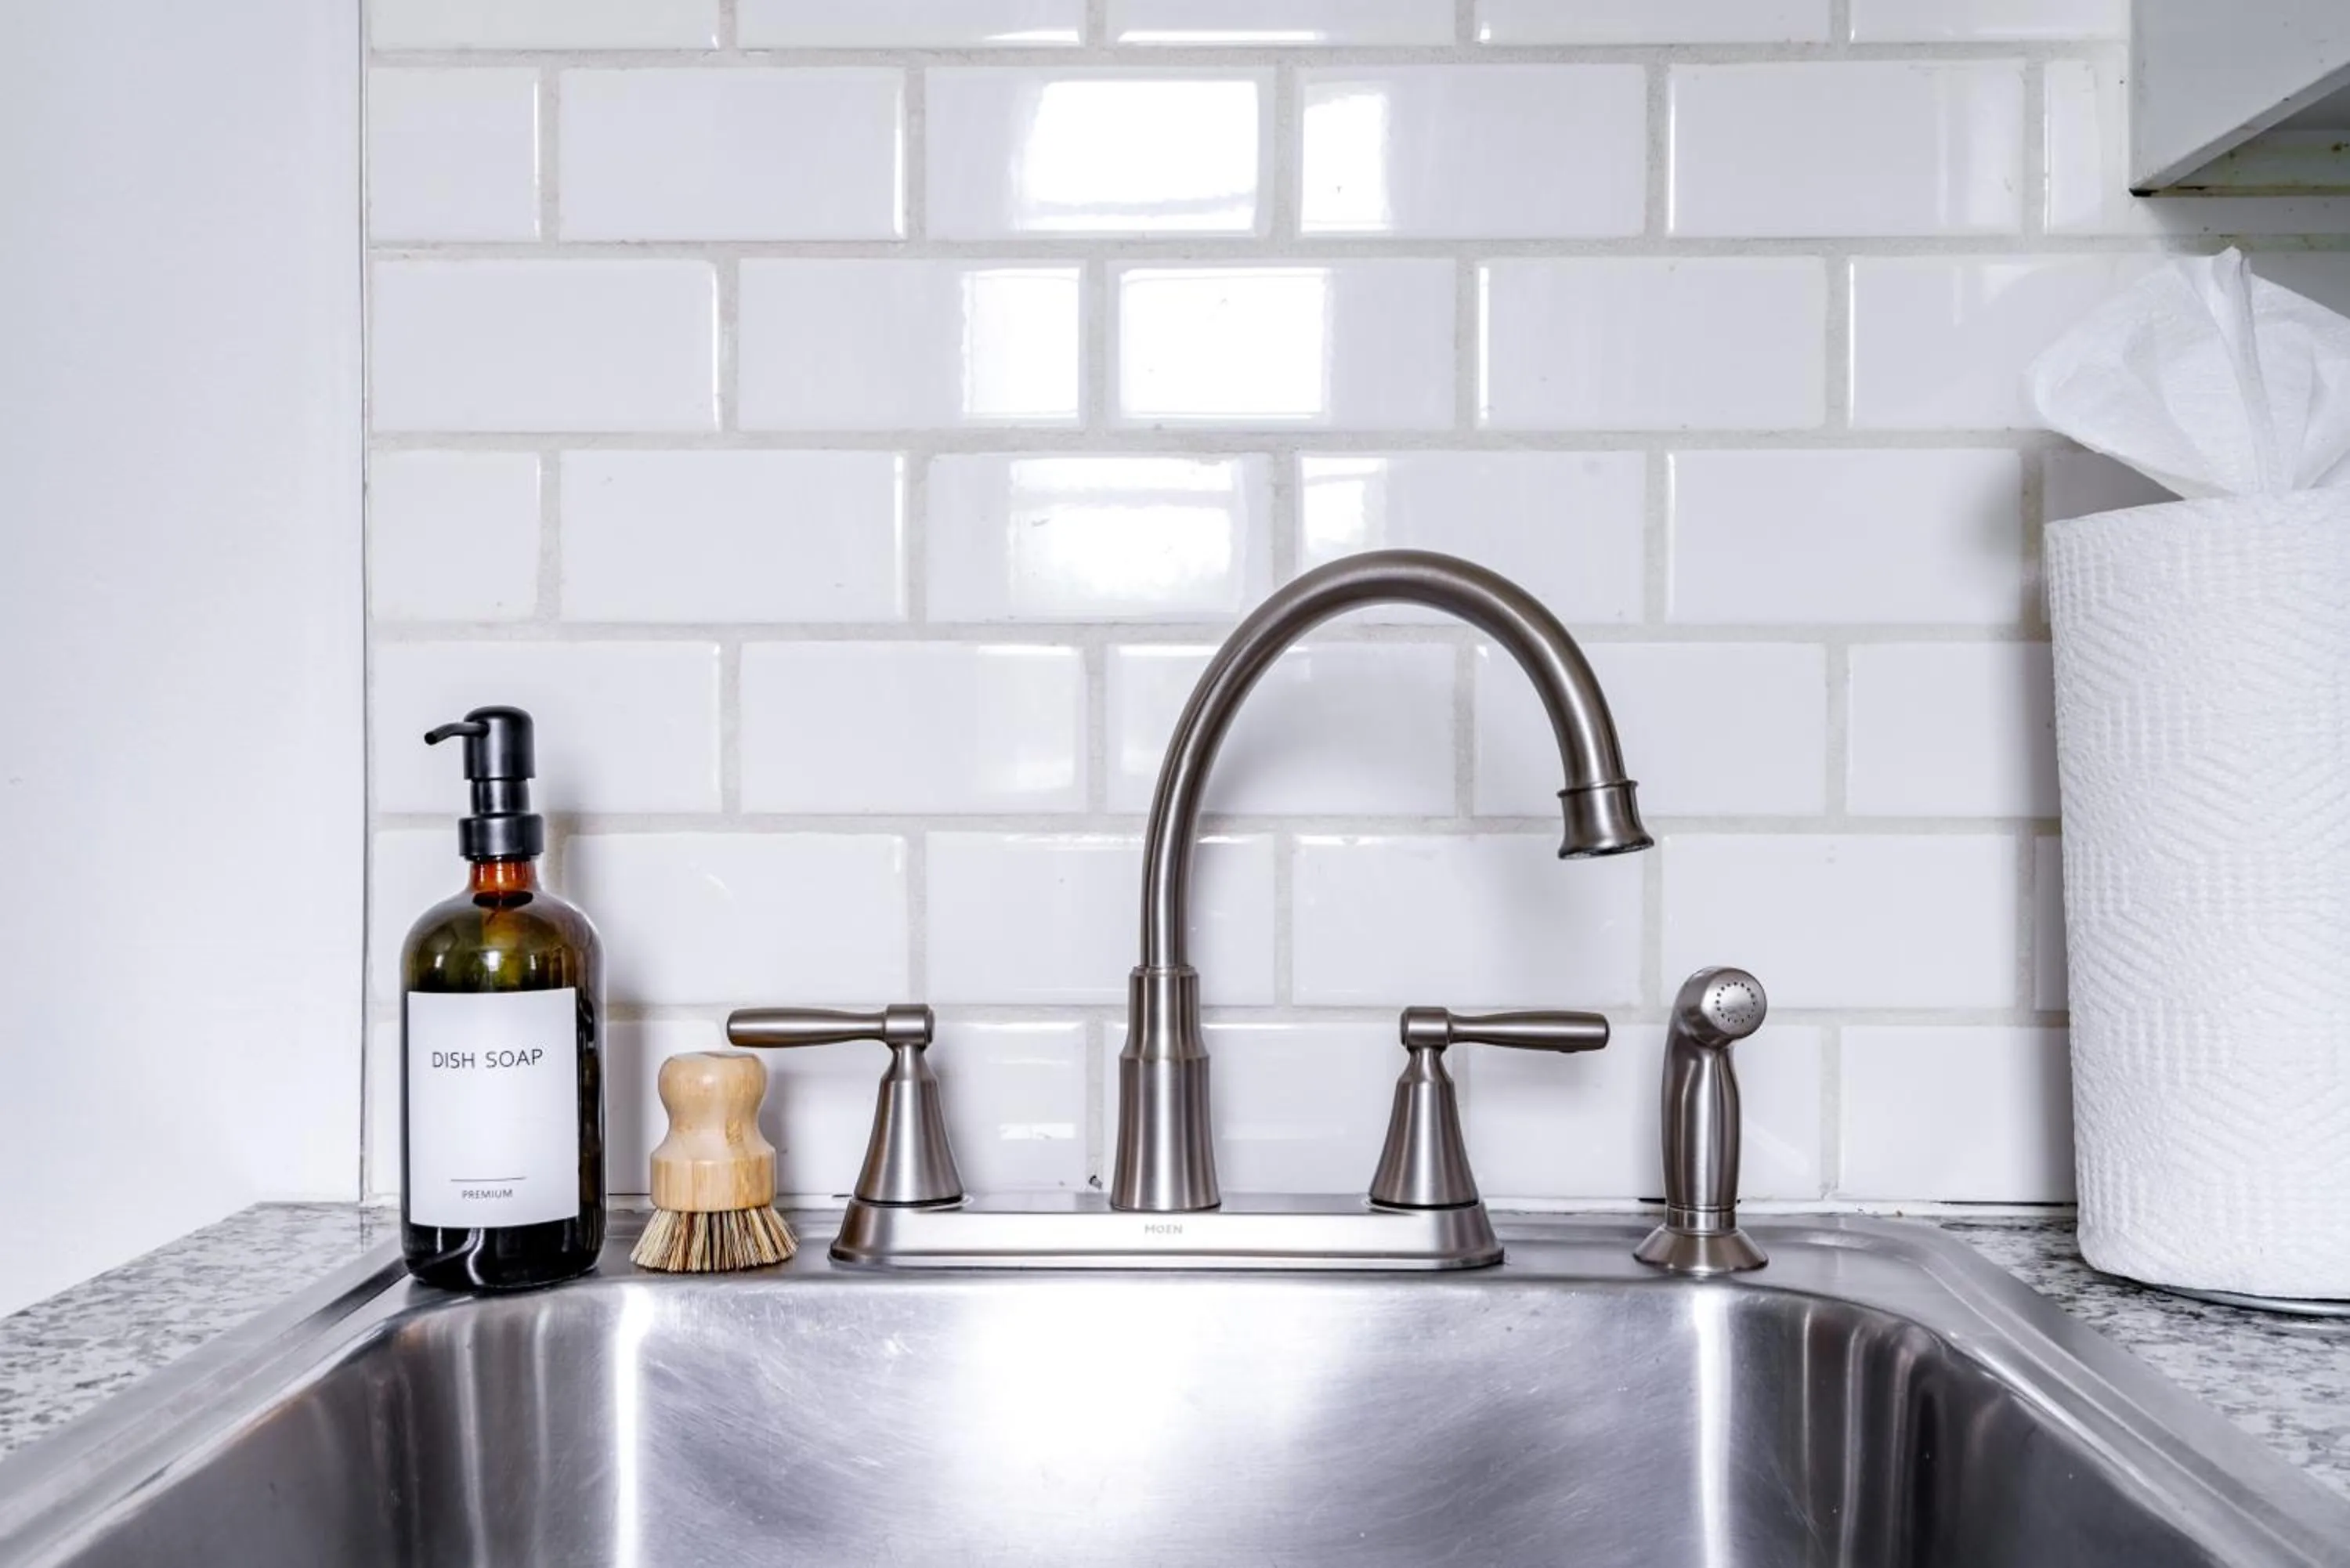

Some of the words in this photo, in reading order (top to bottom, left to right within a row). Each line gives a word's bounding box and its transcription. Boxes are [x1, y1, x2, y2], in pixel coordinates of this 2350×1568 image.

[432, 1051, 475, 1069] DISH
[486, 1048, 544, 1068] SOAP
[461, 1189, 513, 1199] PREMIUM
[1144, 1223, 1184, 1234] MOEN
